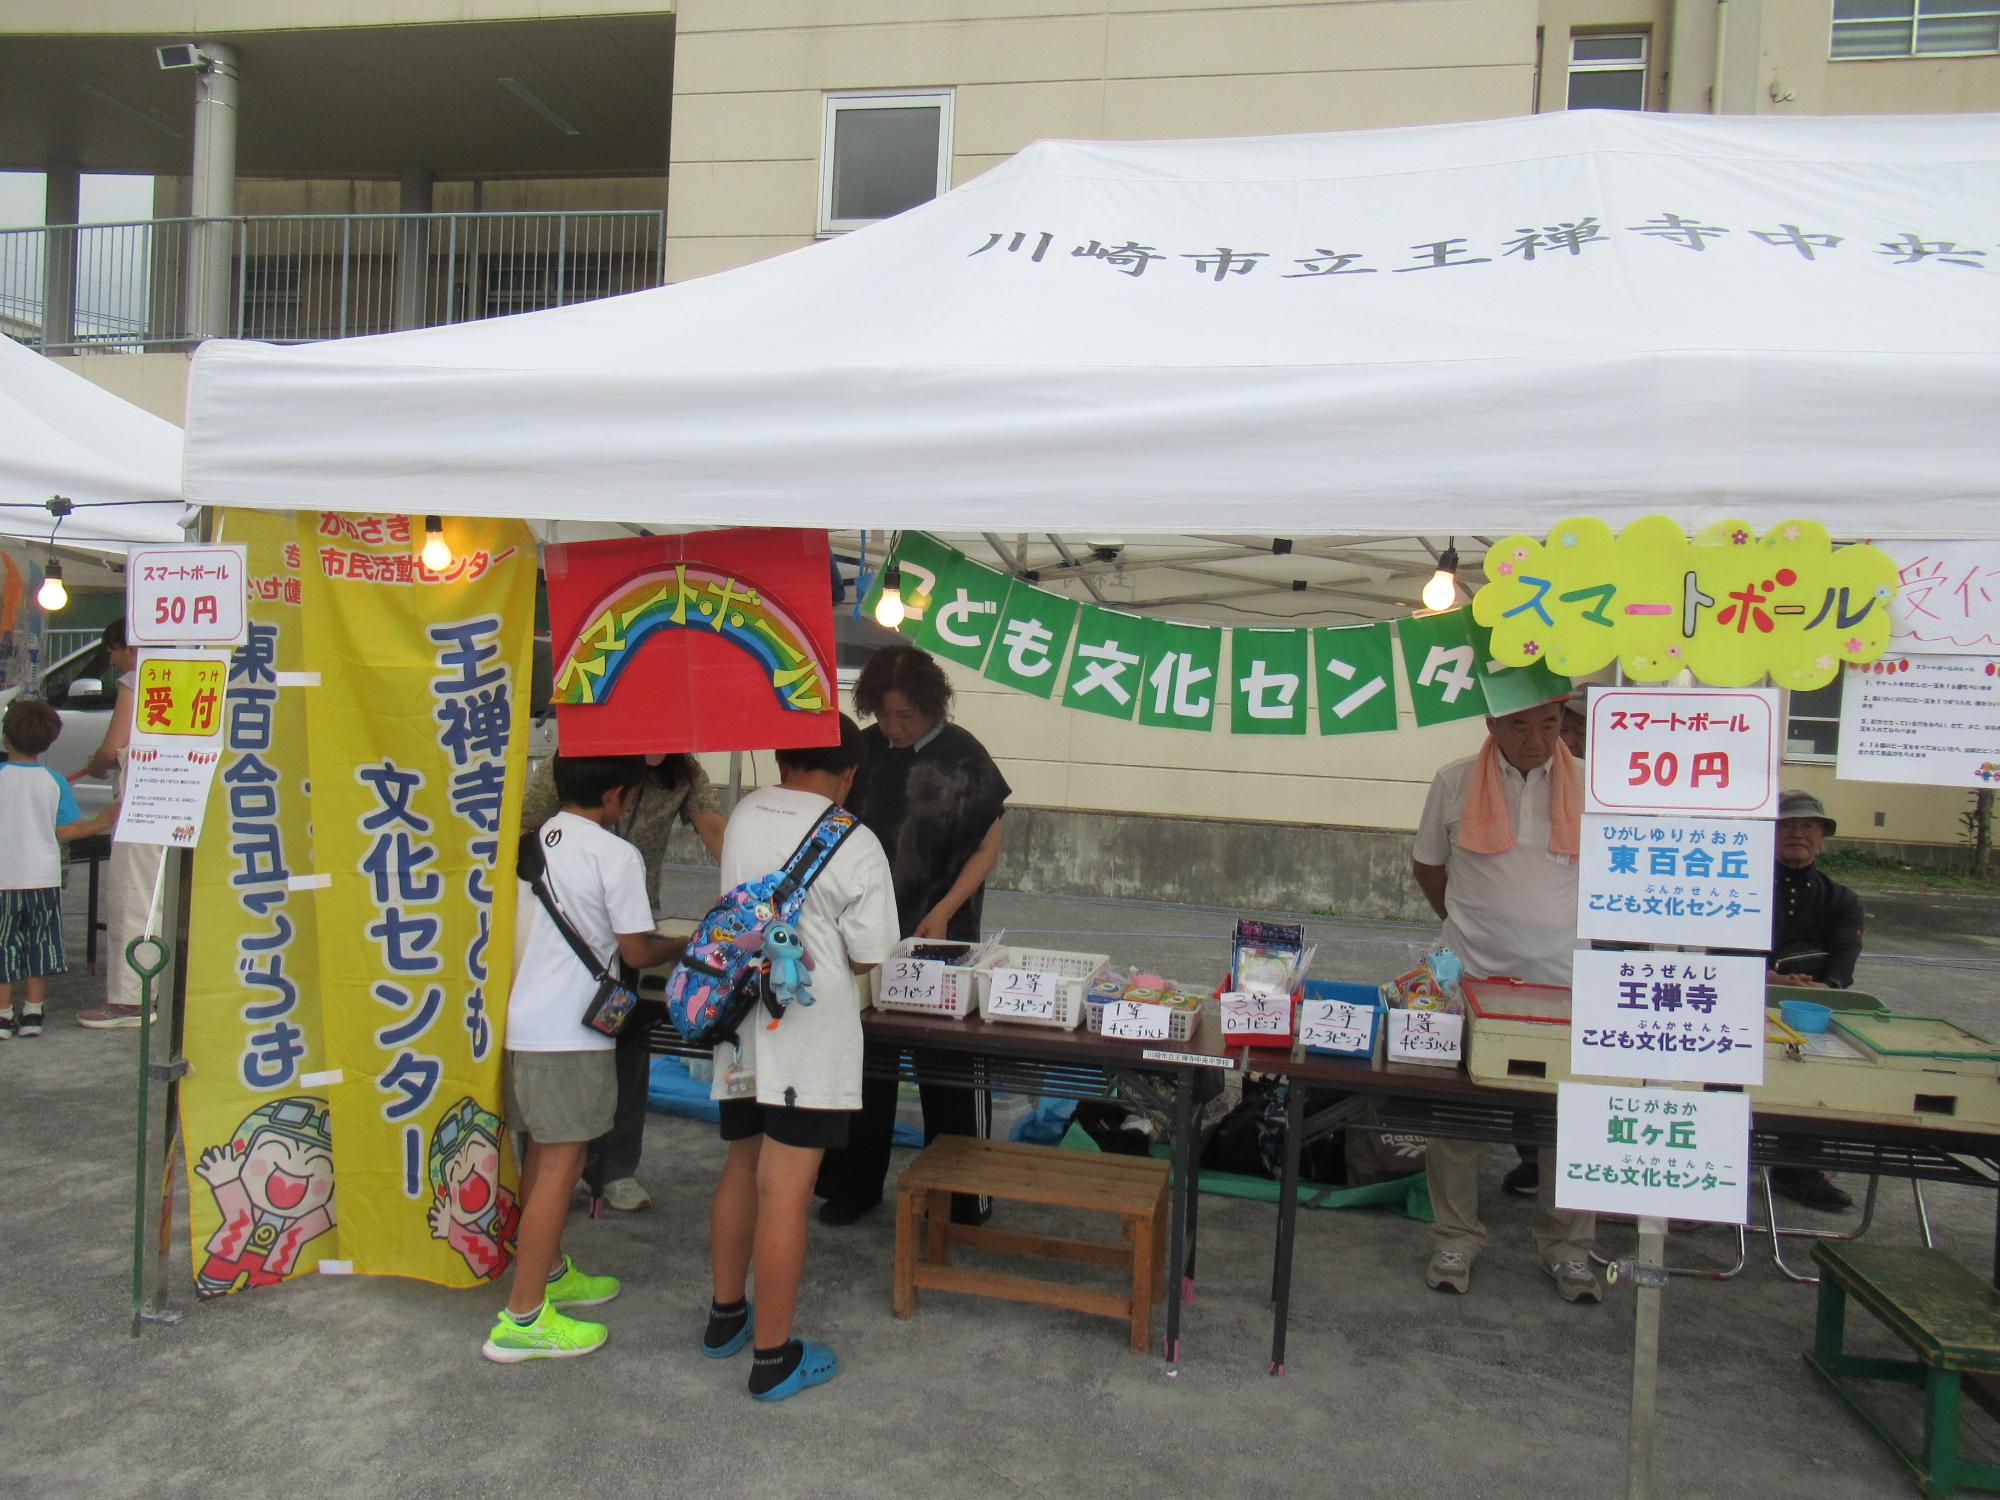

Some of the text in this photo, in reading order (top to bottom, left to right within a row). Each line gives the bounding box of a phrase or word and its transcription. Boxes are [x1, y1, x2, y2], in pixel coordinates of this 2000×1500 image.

[968, 211, 2000, 280] 川崎市立王禅寺中央
[143, 565, 230, 582] スマートボール
[1501, 567, 1878, 640] スマートボール
[556, 564, 823, 710] スマートボール
[898, 559, 1508, 720] こども文化センタ
[1609, 710, 1751, 733] スマートボール
[1602, 825, 1749, 846] ひがしゆりがおか
[1607, 845, 1750, 879] 東百合丘
[1644, 884, 1759, 898] ぶんかせんたー
[1588, 893, 1761, 919] こども文化センター
[360, 762, 441, 1194] 文化センター
[1619, 962, 1718, 980] おうぜんじ
[1616, 981, 1719, 1014] 王禅寺
[1637, 1019, 1749, 1033] ぶんかせんたー
[1581, 1028, 1753, 1054] こども文化センター
[1608, 1096, 1698, 1116] にじがおか
[1621, 1154, 1734, 1171] ぶんかせんたー
[1566, 1162, 1737, 1191] こども文化センター
